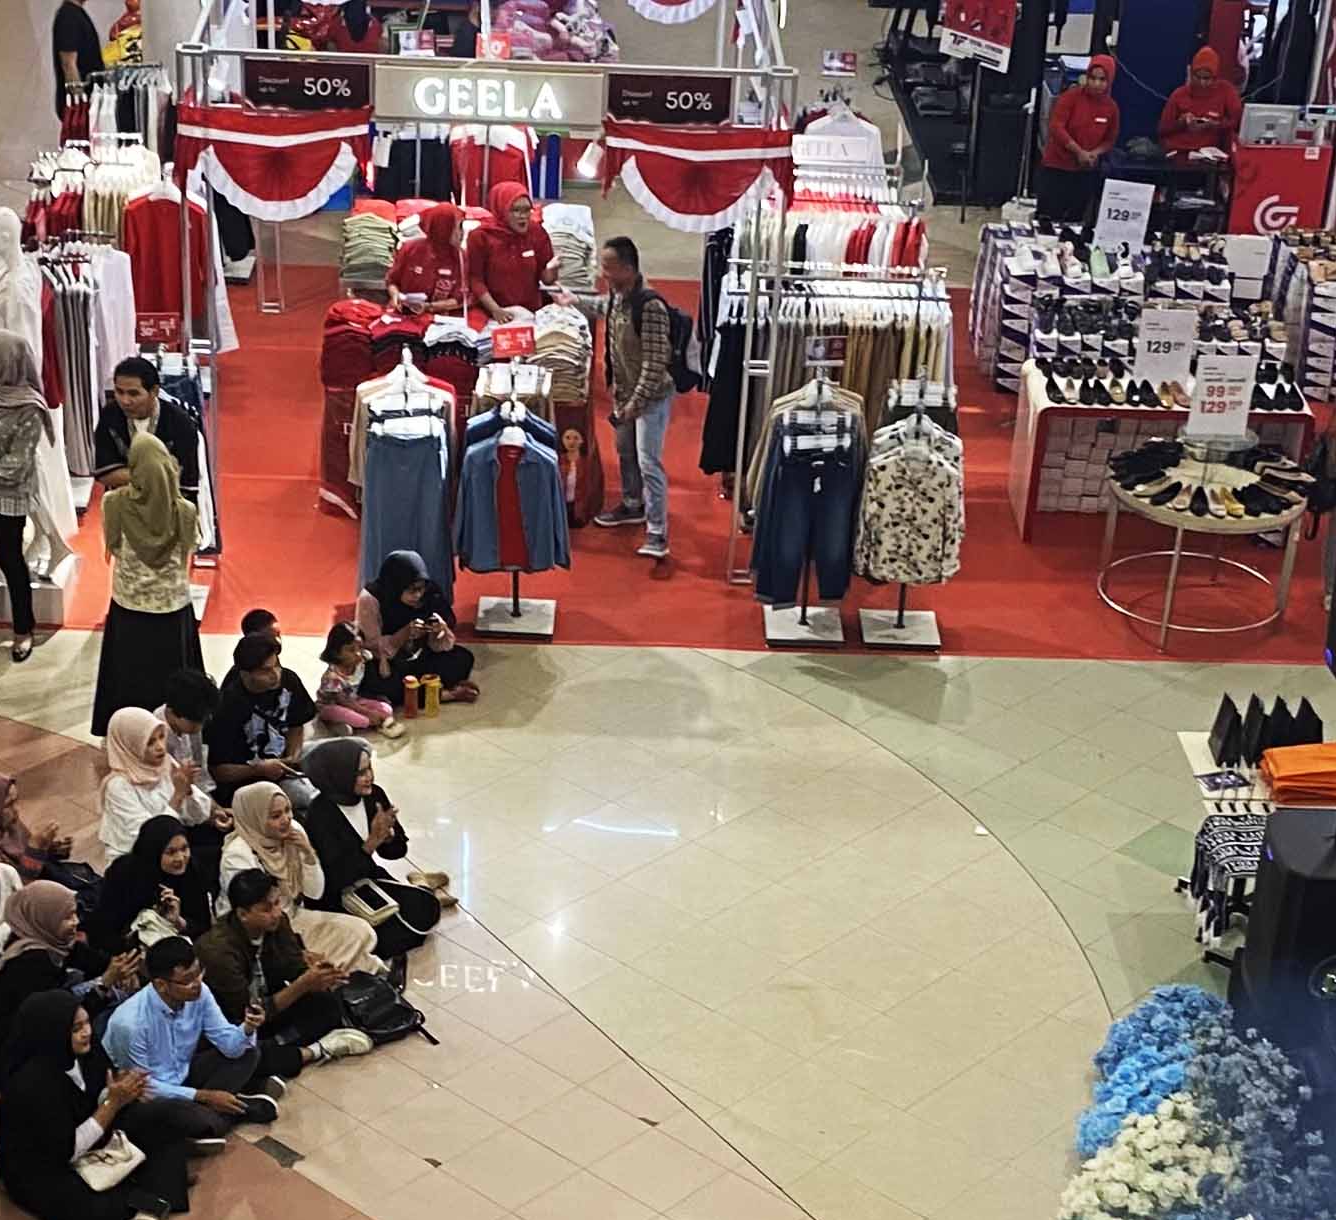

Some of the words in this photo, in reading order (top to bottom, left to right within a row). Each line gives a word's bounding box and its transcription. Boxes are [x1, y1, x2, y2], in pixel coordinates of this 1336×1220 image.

[302, 78, 352, 97] 50%
[414, 77, 563, 120] GEELA
[665, 90, 713, 111] 50%
[1107, 207, 1130, 222] 129
[1147, 340, 1172, 354] 129
[1207, 385, 1225, 398] 99
[1200, 400, 1226, 414] 129
